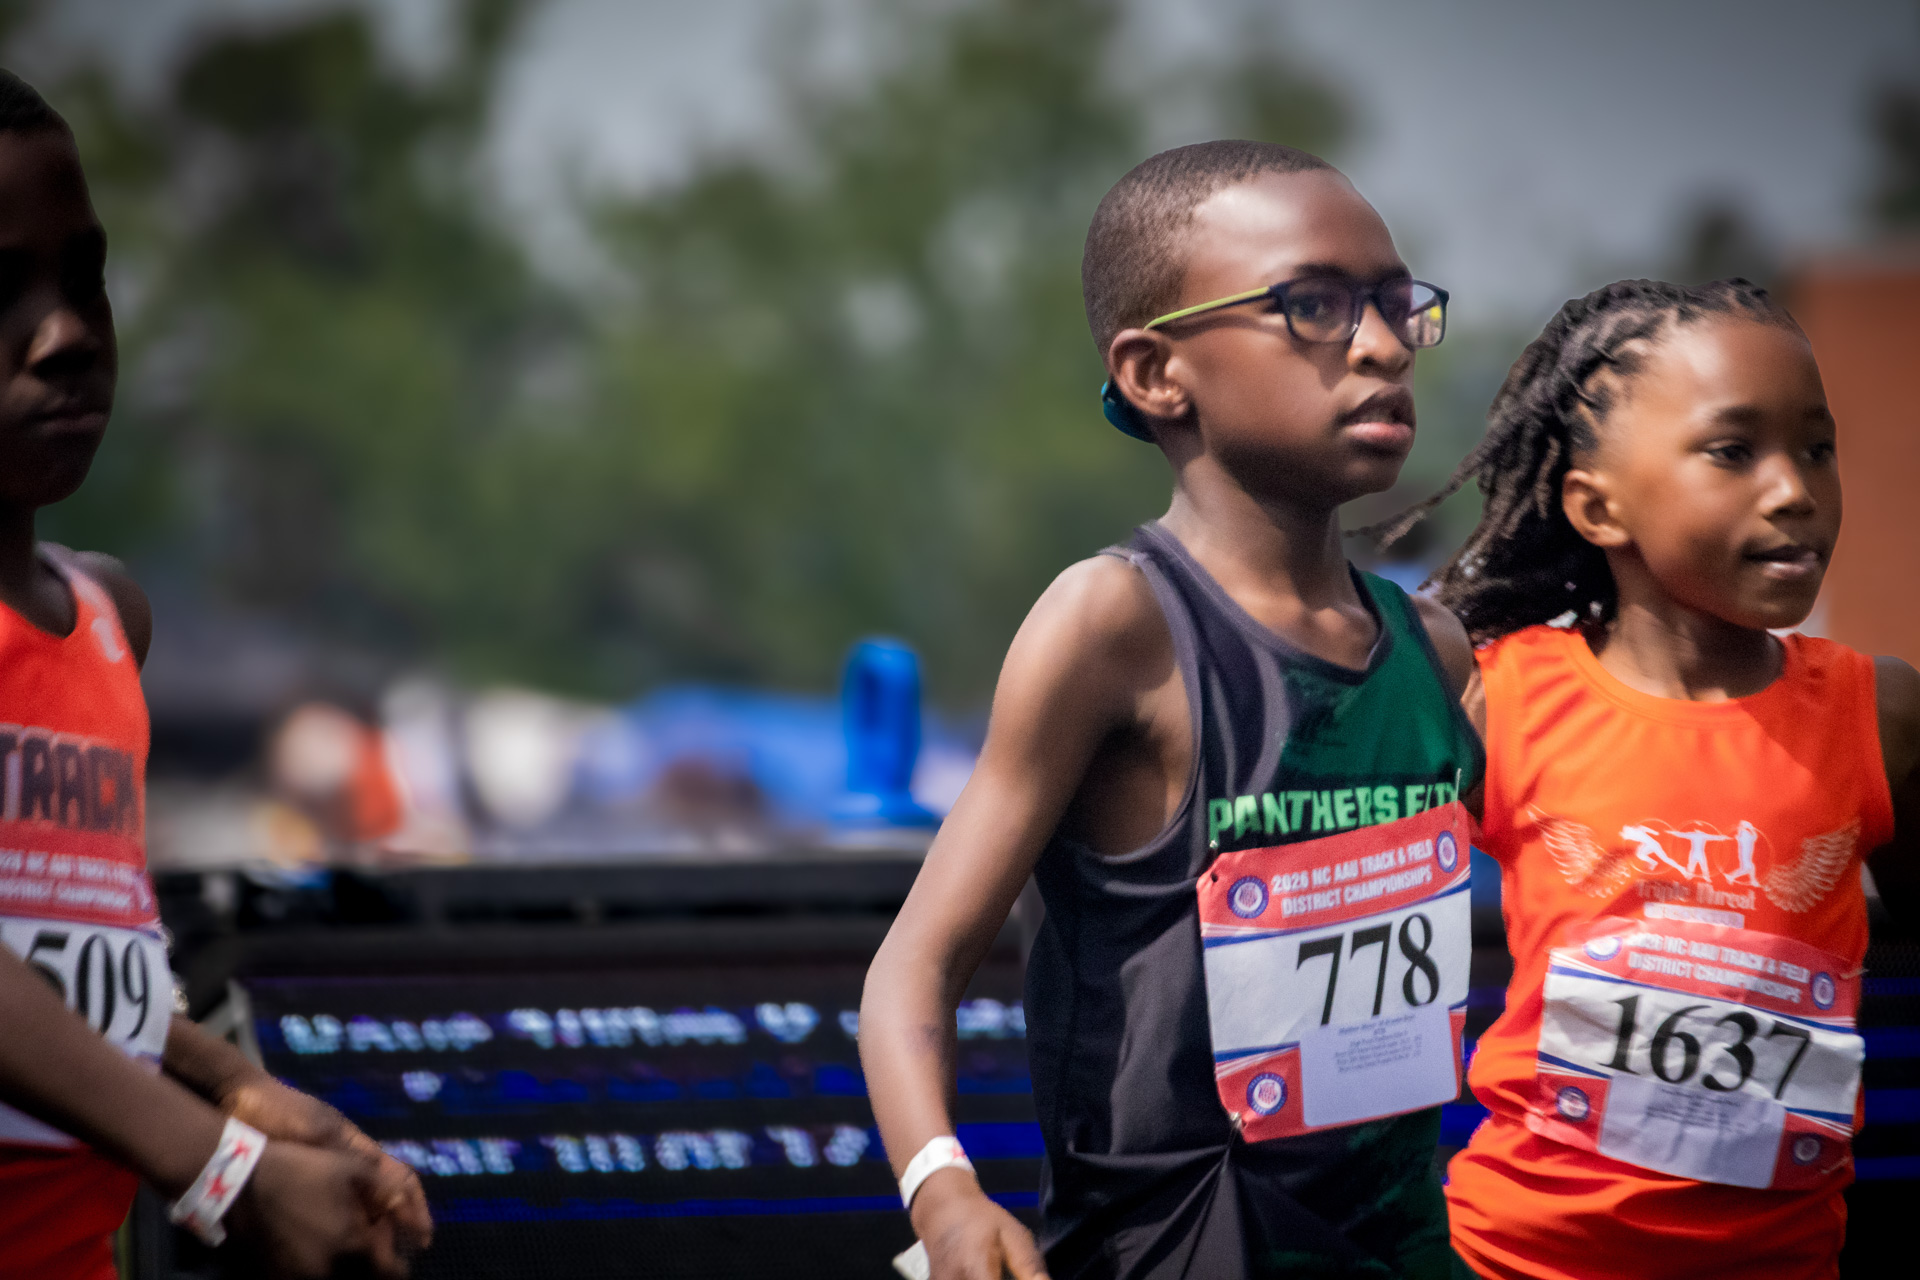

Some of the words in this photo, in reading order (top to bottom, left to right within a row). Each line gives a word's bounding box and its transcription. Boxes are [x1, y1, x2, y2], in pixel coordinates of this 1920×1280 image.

[1209, 785, 1399, 847] PANTHERS
[1282, 887, 1341, 918] DISTRICT
[1344, 864, 1433, 904] CHAMPIONSHIPS
[1311, 865, 1331, 887] NC
[1333, 859, 1359, 882] AAU
[1360, 850, 1395, 876] TRACK
[1397, 847, 1406, 866] &
[1406, 839, 1433, 862] FIELD
[1296, 912, 1440, 1026] 778
[1628, 952, 1693, 979] DISTRICT
[1595, 994, 1812, 1101] 1637
